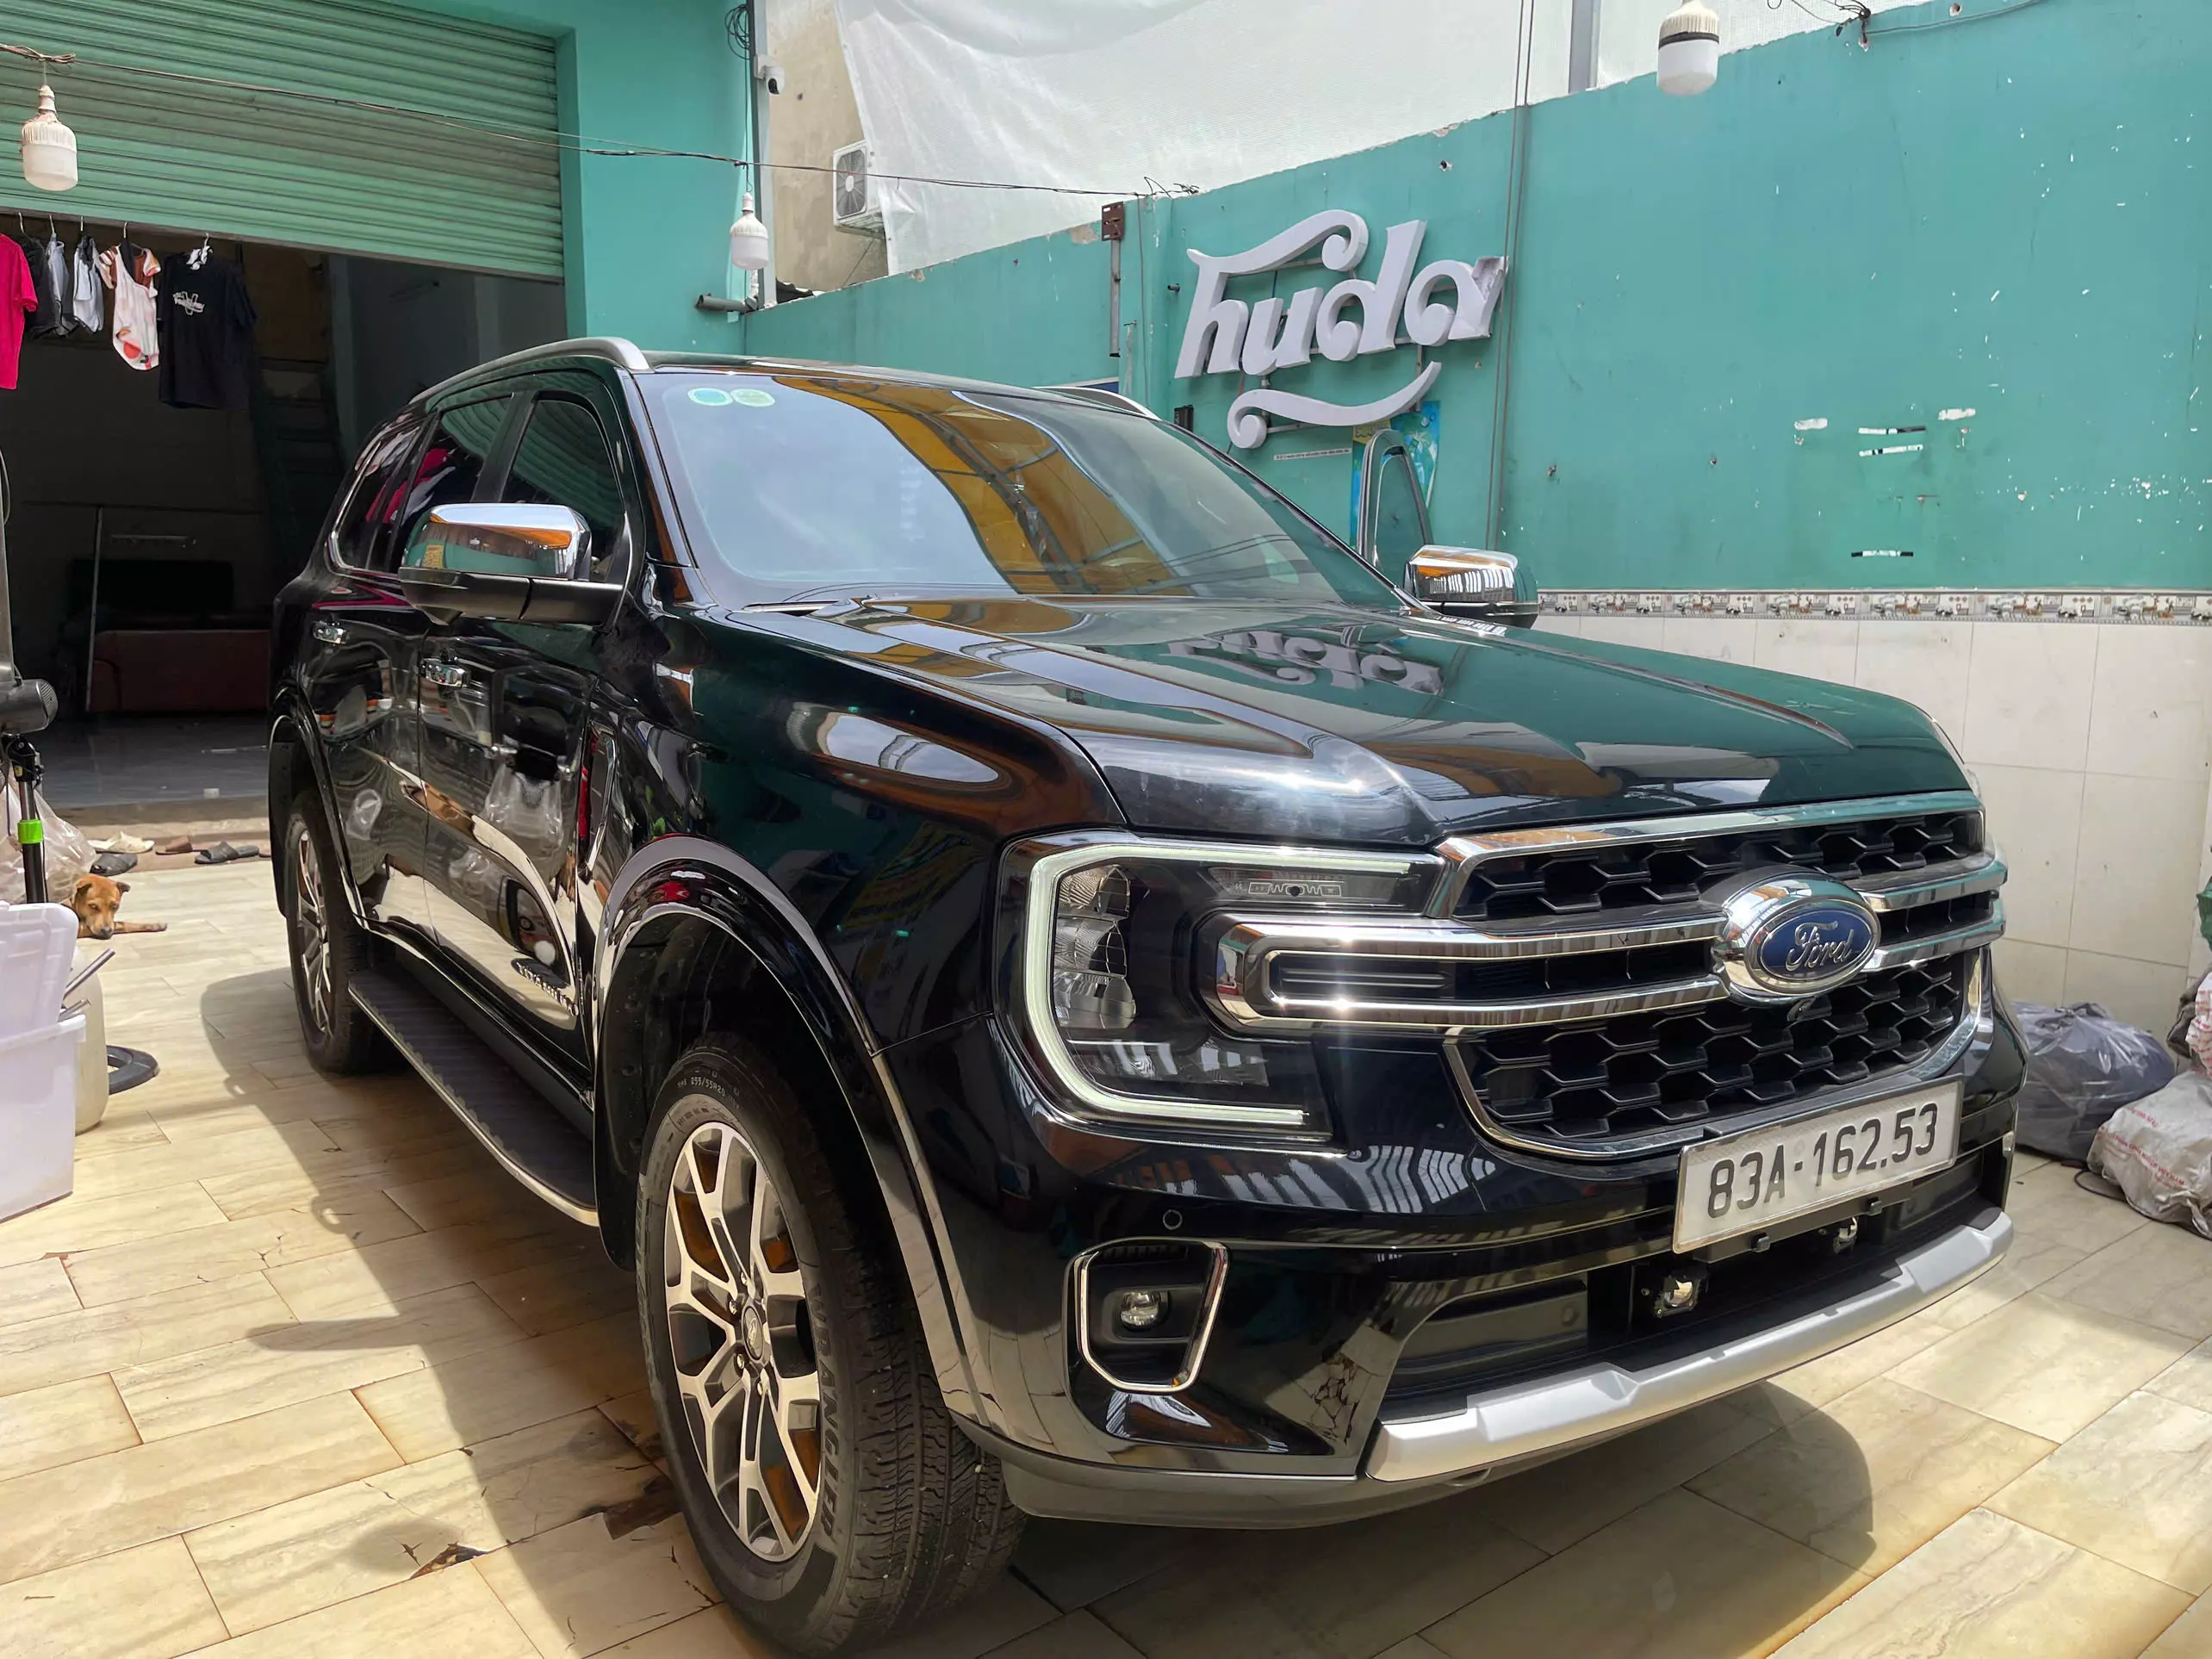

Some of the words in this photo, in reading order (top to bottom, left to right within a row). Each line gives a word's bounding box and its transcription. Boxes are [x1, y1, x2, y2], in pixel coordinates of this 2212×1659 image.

[1175, 209, 1509, 378] huda
[1785, 920, 1855, 972] Ford
[1707, 1103, 1938, 1219] 83A-162.53
[808, 1283, 840, 1538] WRANGLER
